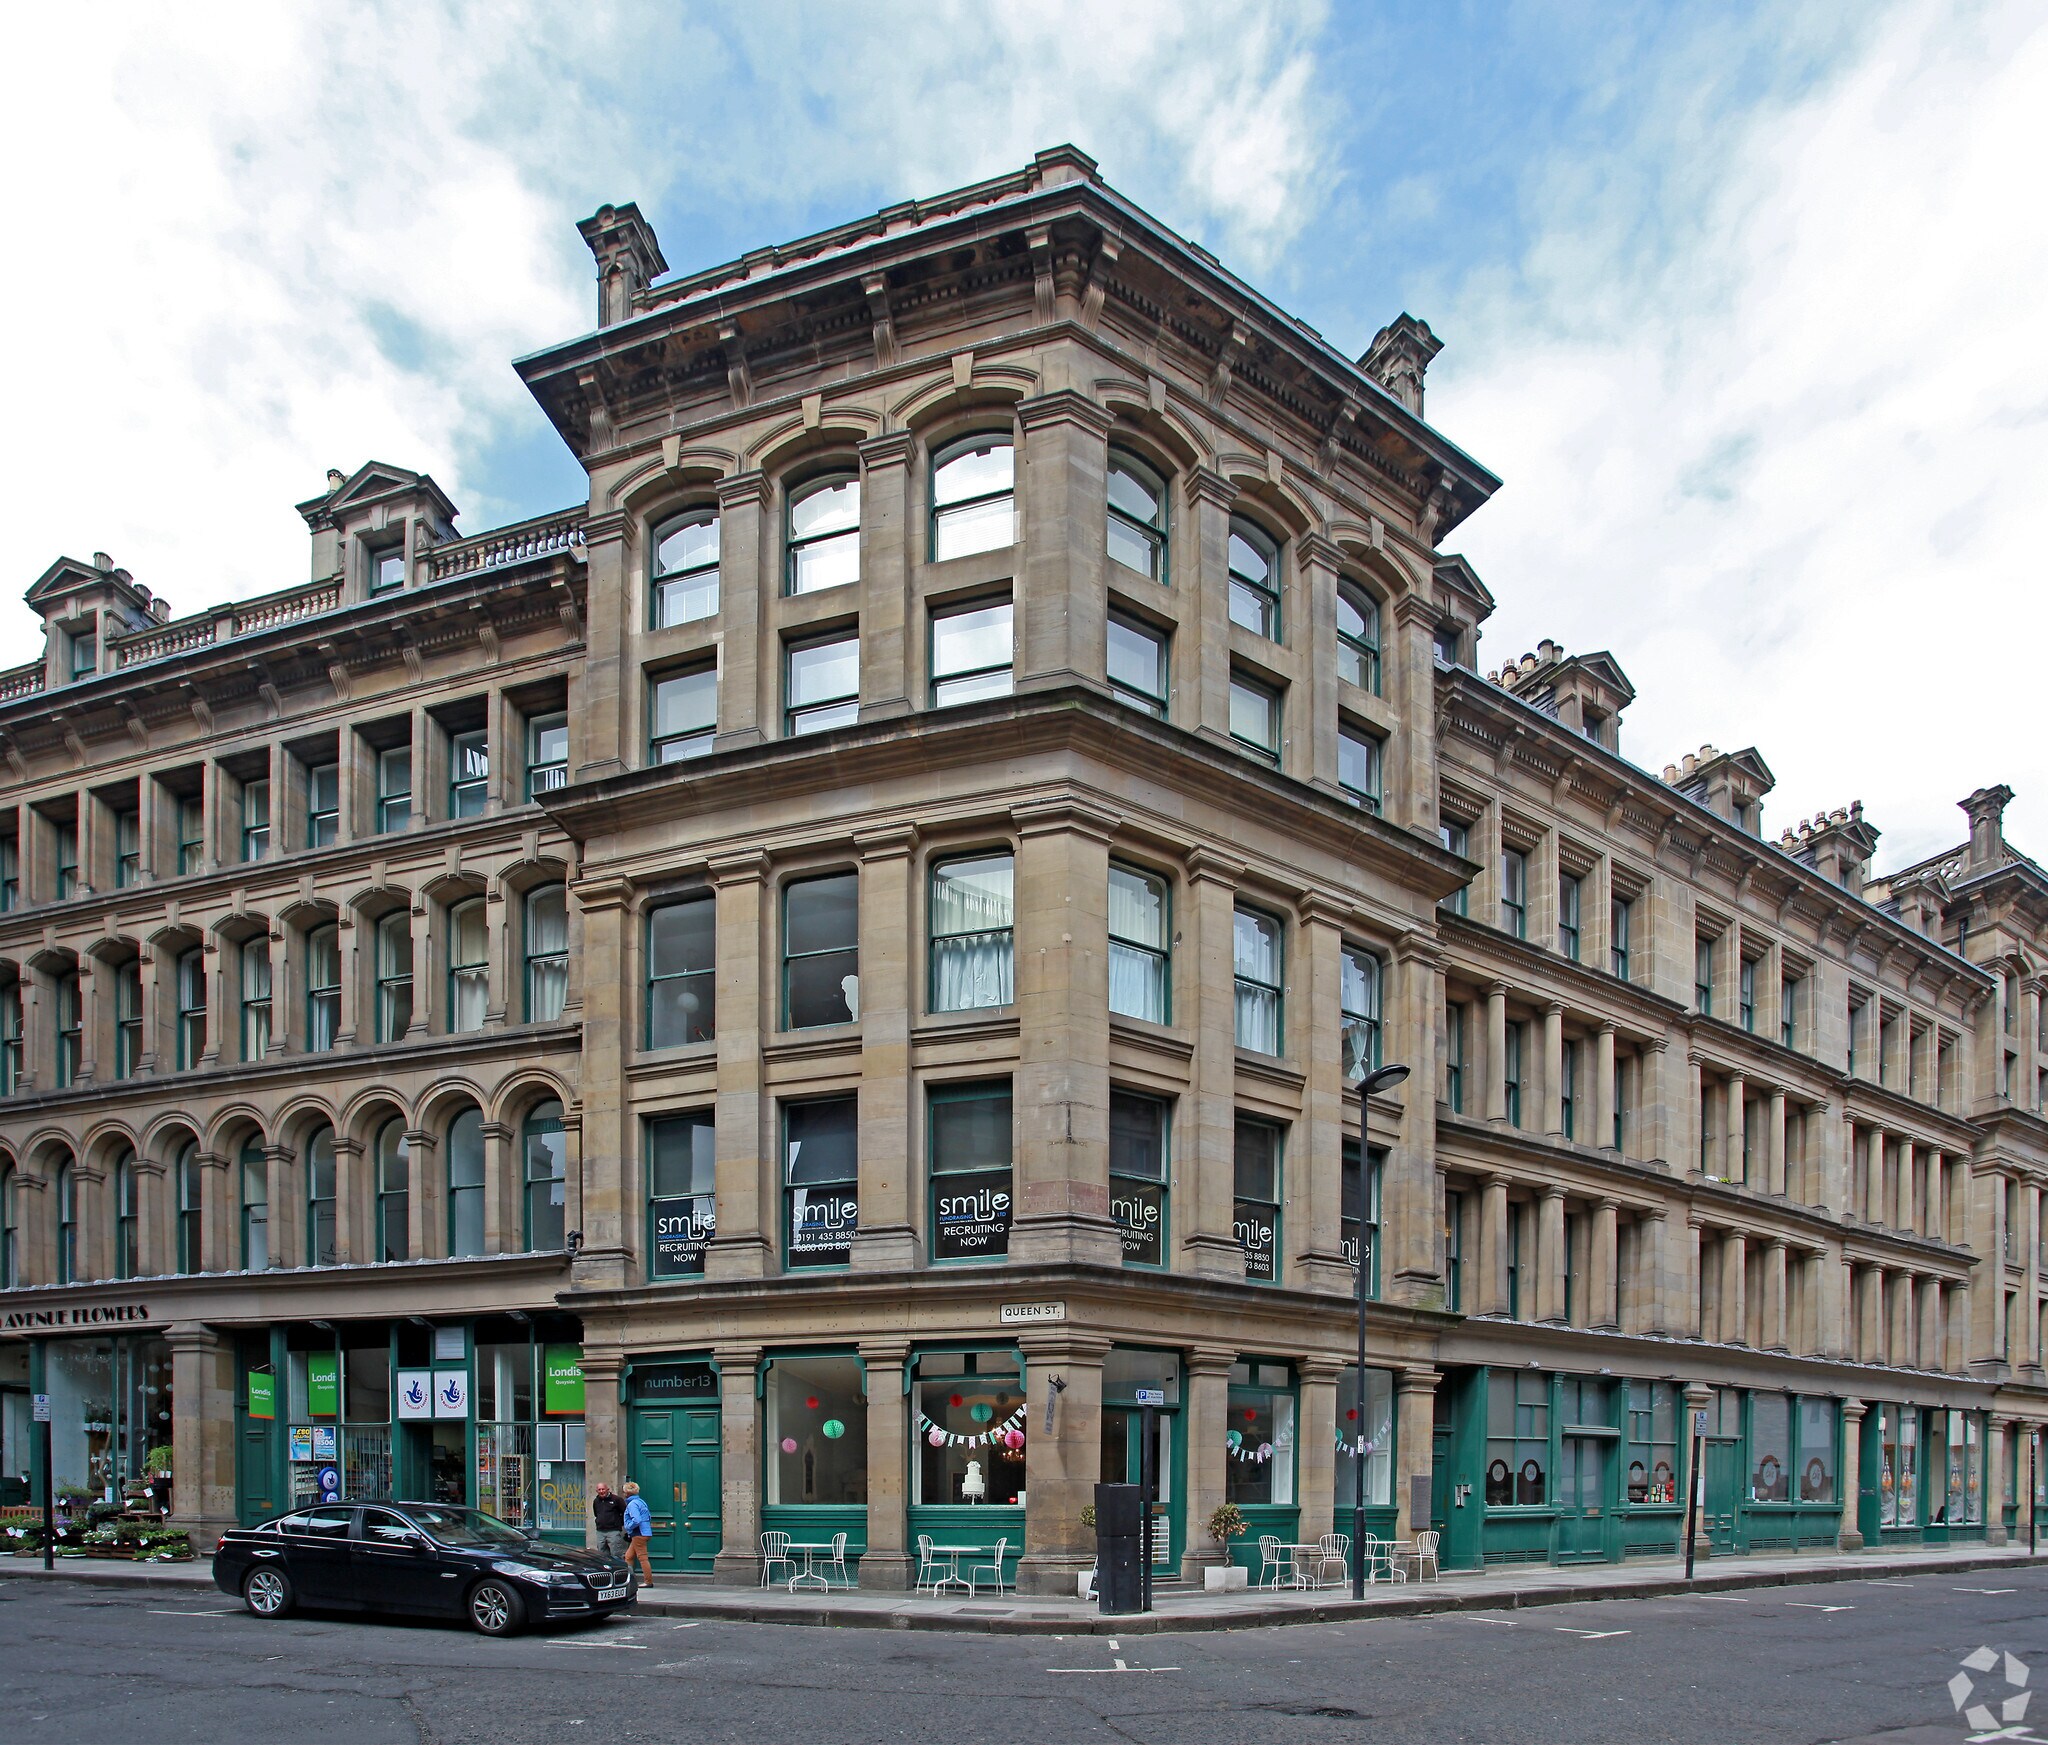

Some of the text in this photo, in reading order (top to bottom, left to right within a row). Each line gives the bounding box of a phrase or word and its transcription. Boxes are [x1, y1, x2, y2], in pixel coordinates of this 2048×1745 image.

[940, 1189, 1010, 1222] smile
[793, 1198, 858, 1229] smile
[1111, 1197, 1158, 1230] mile
[658, 1210, 716, 1240] smile
[944, 1223, 1004, 1236] RECRUITING
[797, 1230, 856, 1241] 0191 435 8850
[1121, 1229, 1154, 1242] RUITING
[1232, 1219, 1272, 1249] mile
[660, 1241, 711, 1252] RECRUITING
[835, 1241, 851, 1250] 860
[961, 1236, 987, 1246] NOW
[673, 1253, 697, 1262] NOW
[1244, 1251, 1270, 1262] 35 8850
[1245, 1261, 1270, 1272] 93 8603
[5, 1310, 68, 1328] AVENUE
[72, 1304, 149, 1324] FLOWERS
[1005, 1305, 1060, 1317] QUEEN ST.
[312, 1372, 336, 1382] Londi
[549, 1366, 581, 1377] Londis
[644, 1375, 711, 1388] number13
[251, 1387, 271, 1396] Londis
[443, 1401, 458, 1410] National
[541, 1483, 580, 1501] QUAY
